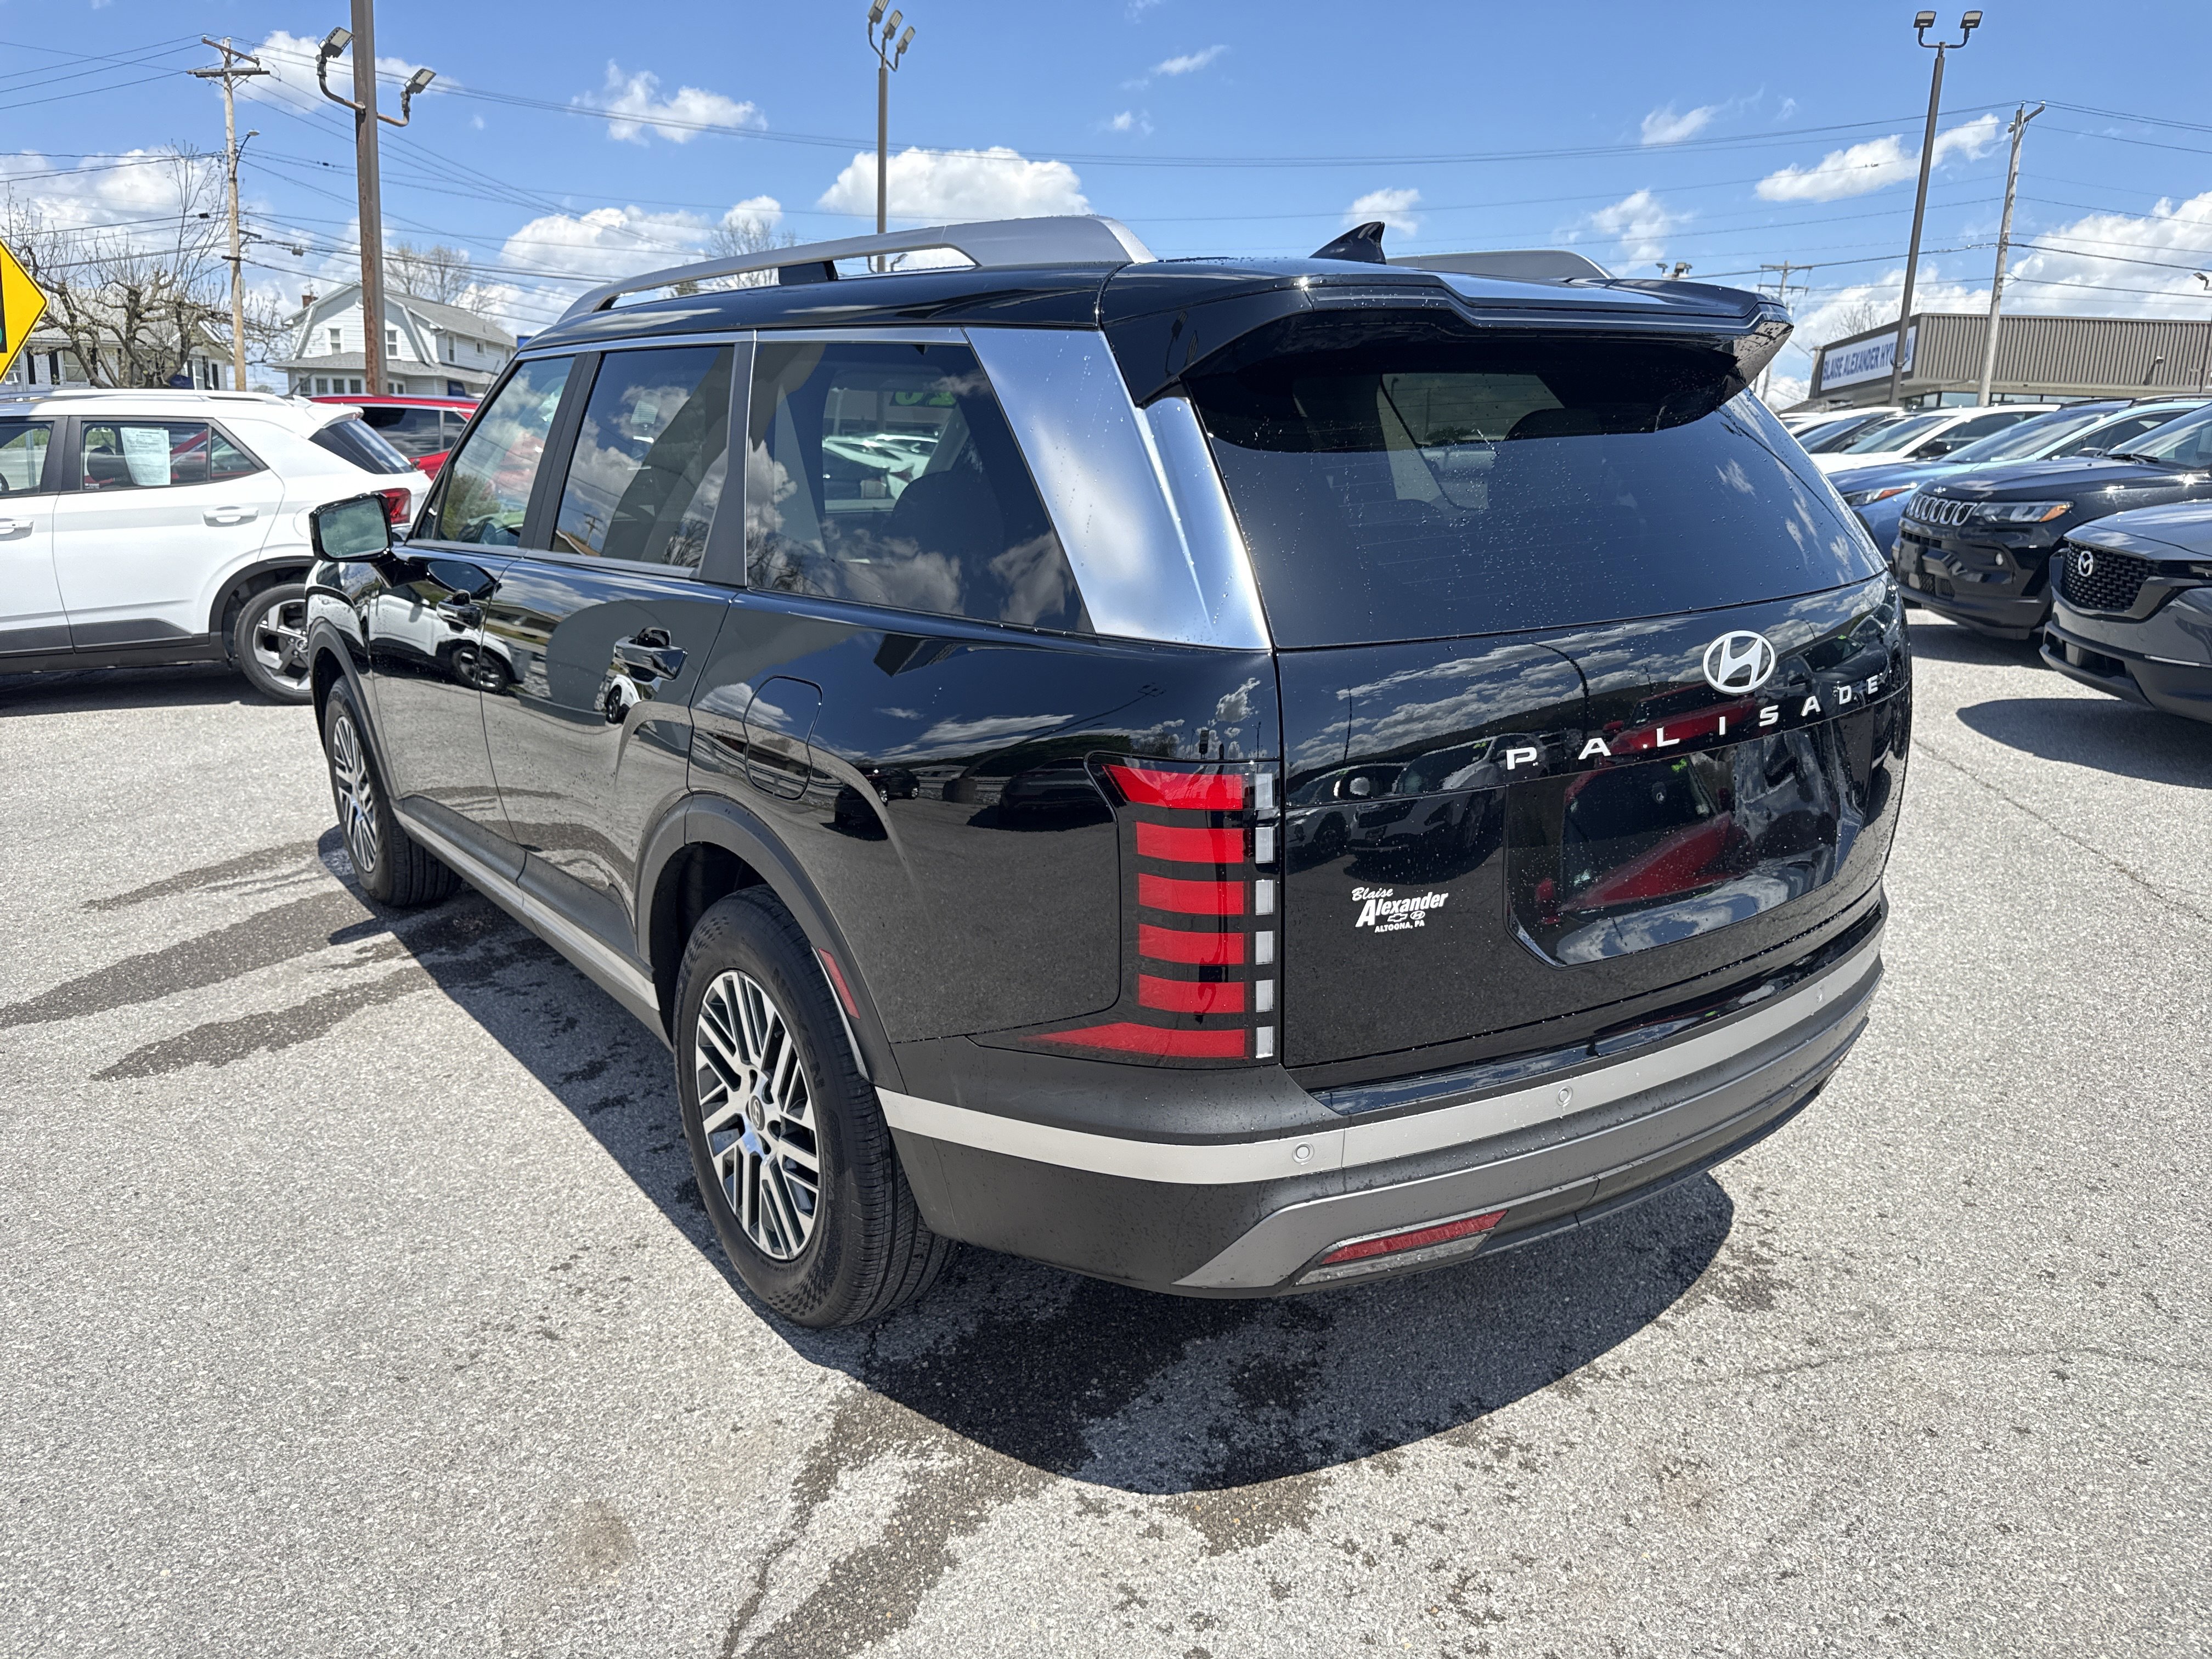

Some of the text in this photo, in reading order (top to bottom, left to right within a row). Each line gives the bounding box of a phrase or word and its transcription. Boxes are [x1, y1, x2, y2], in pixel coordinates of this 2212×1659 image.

[1822, 337, 1912, 381] BLAISE ALEXANDER HYUAI
[1506, 674, 1878, 770] PALISADE
[1351, 887, 1393, 901] Blaise
[1355, 891, 1449, 928] Alexander
[1374, 922, 1413, 933] ALTOONA,
